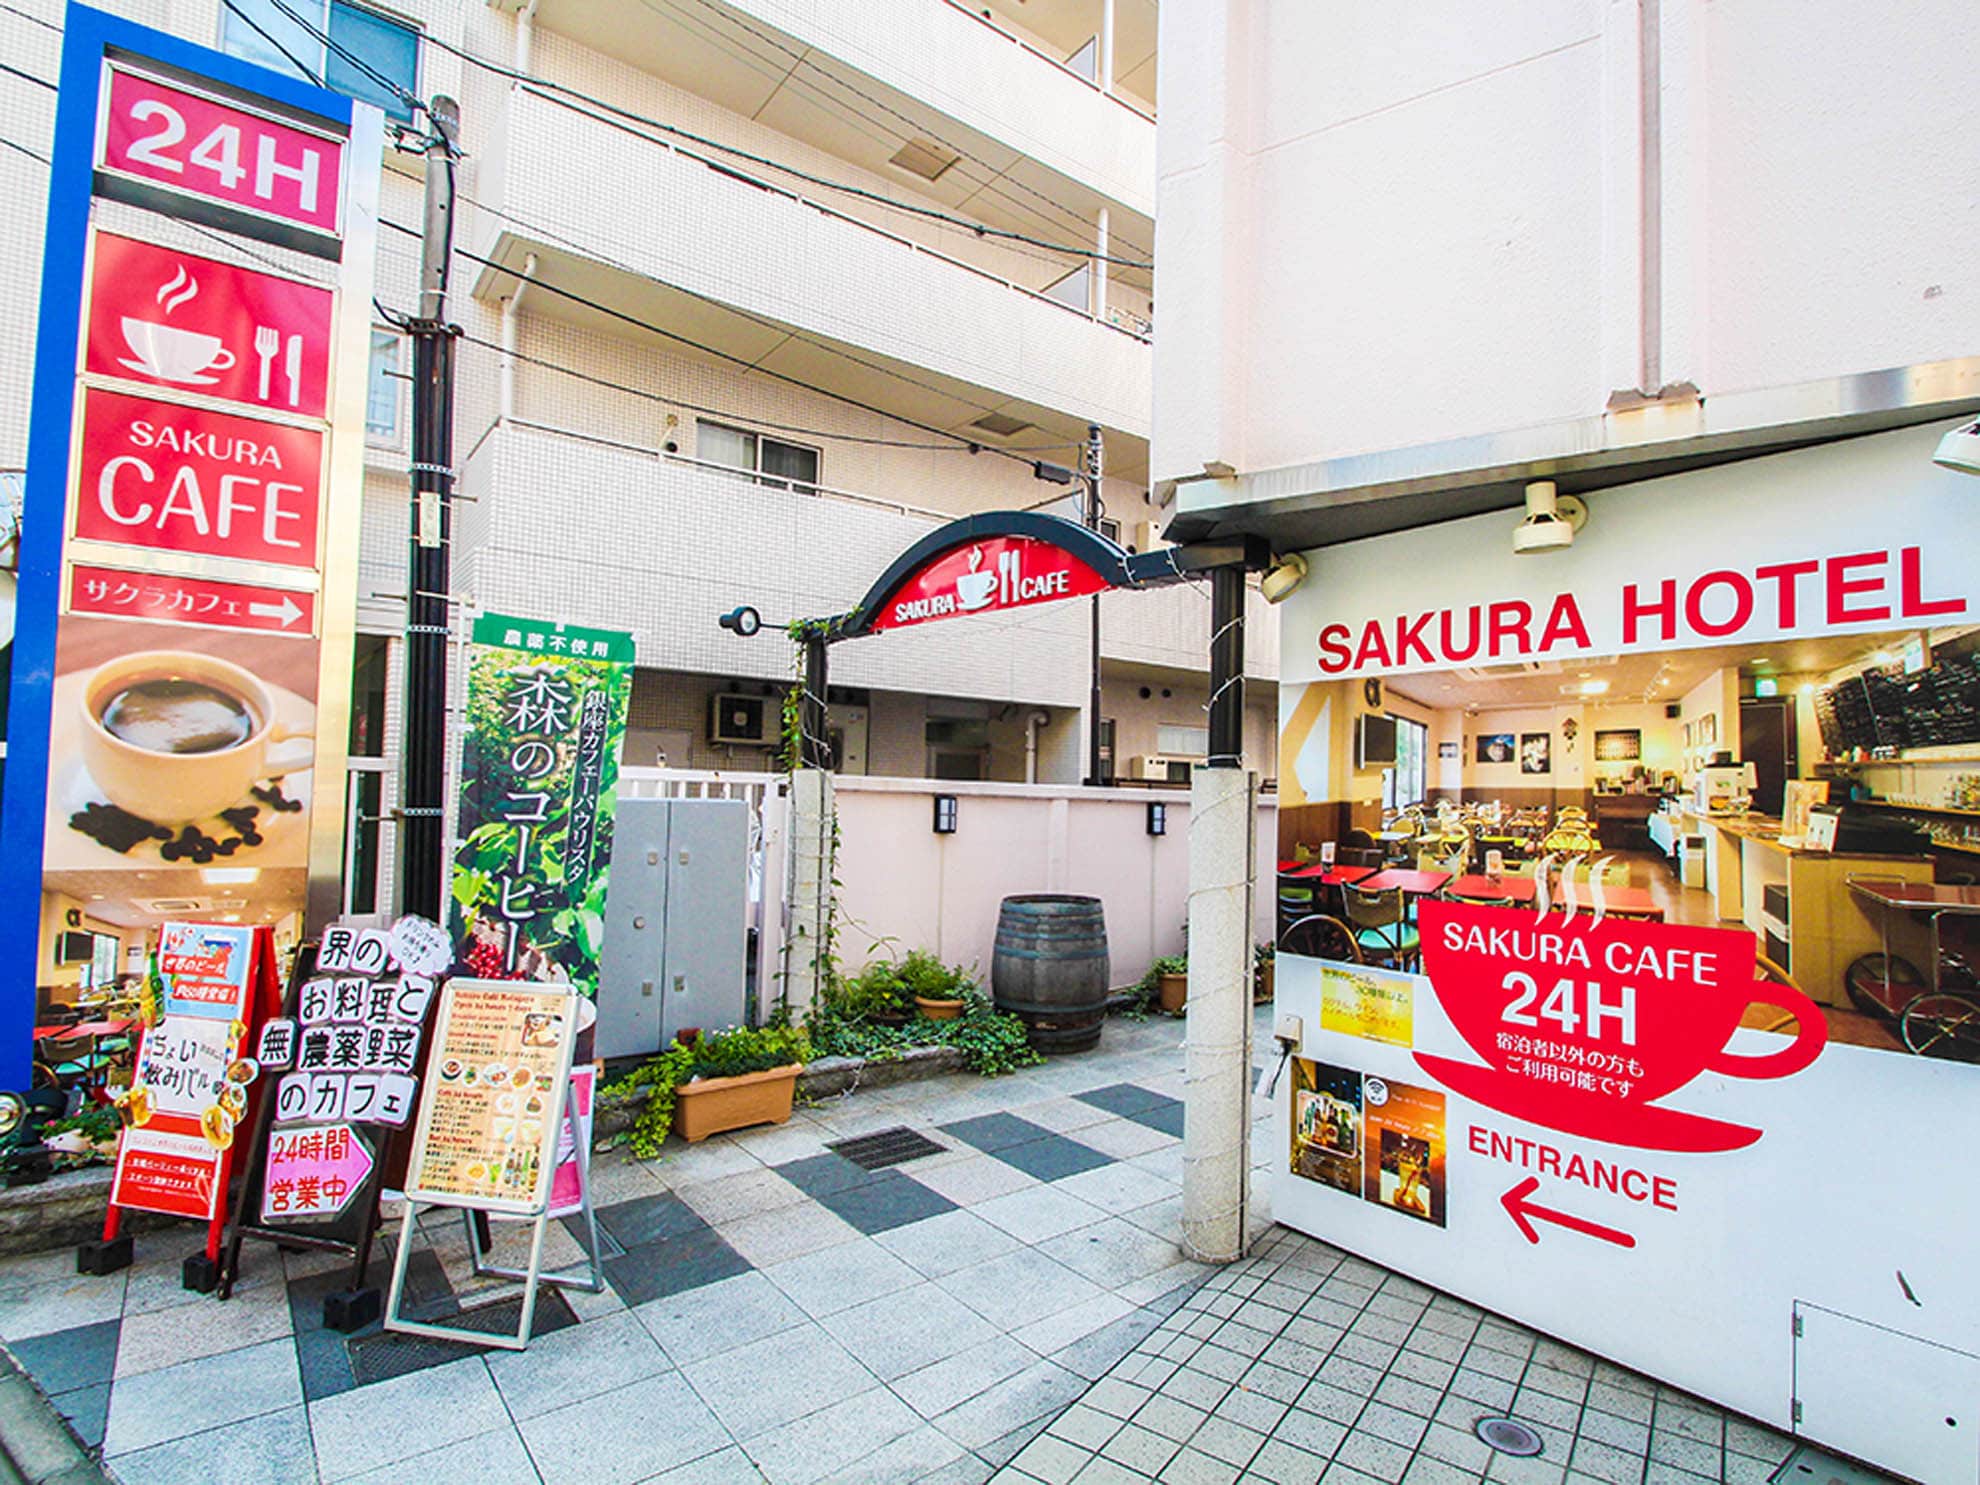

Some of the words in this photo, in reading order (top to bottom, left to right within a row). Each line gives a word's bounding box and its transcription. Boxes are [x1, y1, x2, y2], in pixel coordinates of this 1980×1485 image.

[126, 99, 320, 213] 24H
[129, 420, 282, 470] SAKURA
[98, 455, 304, 548] CAFE
[84, 579, 241, 616] サクラカフェ
[895, 594, 956, 622] SAKURA
[1020, 570, 1069, 599] CAFE
[1317, 592, 1592, 674] SAKURA
[1623, 546, 1967, 644] HOTEL
[504, 629, 609, 658] 農薬不使用
[500, 673, 573, 972] 森のコーヒー
[323, 930, 383, 967] 界の
[1443, 922, 1592, 969] SAKURA
[1605, 941, 1718, 987] CAFE
[302, 980, 424, 1023] お料理と
[1501, 970, 1636, 1046] 24H
[262, 1026, 416, 1068] 無農薬野菜
[1496, 1032, 1645, 1078] 宿泊者以外の方も
[280, 1080, 401, 1114] のカフェ
[1506, 1055, 1634, 1098] ご利用可能です
[273, 1127, 351, 1165] 24時間
[1469, 1125, 1678, 1212] ENTRANCE
[270, 1175, 348, 1212] 営業中
